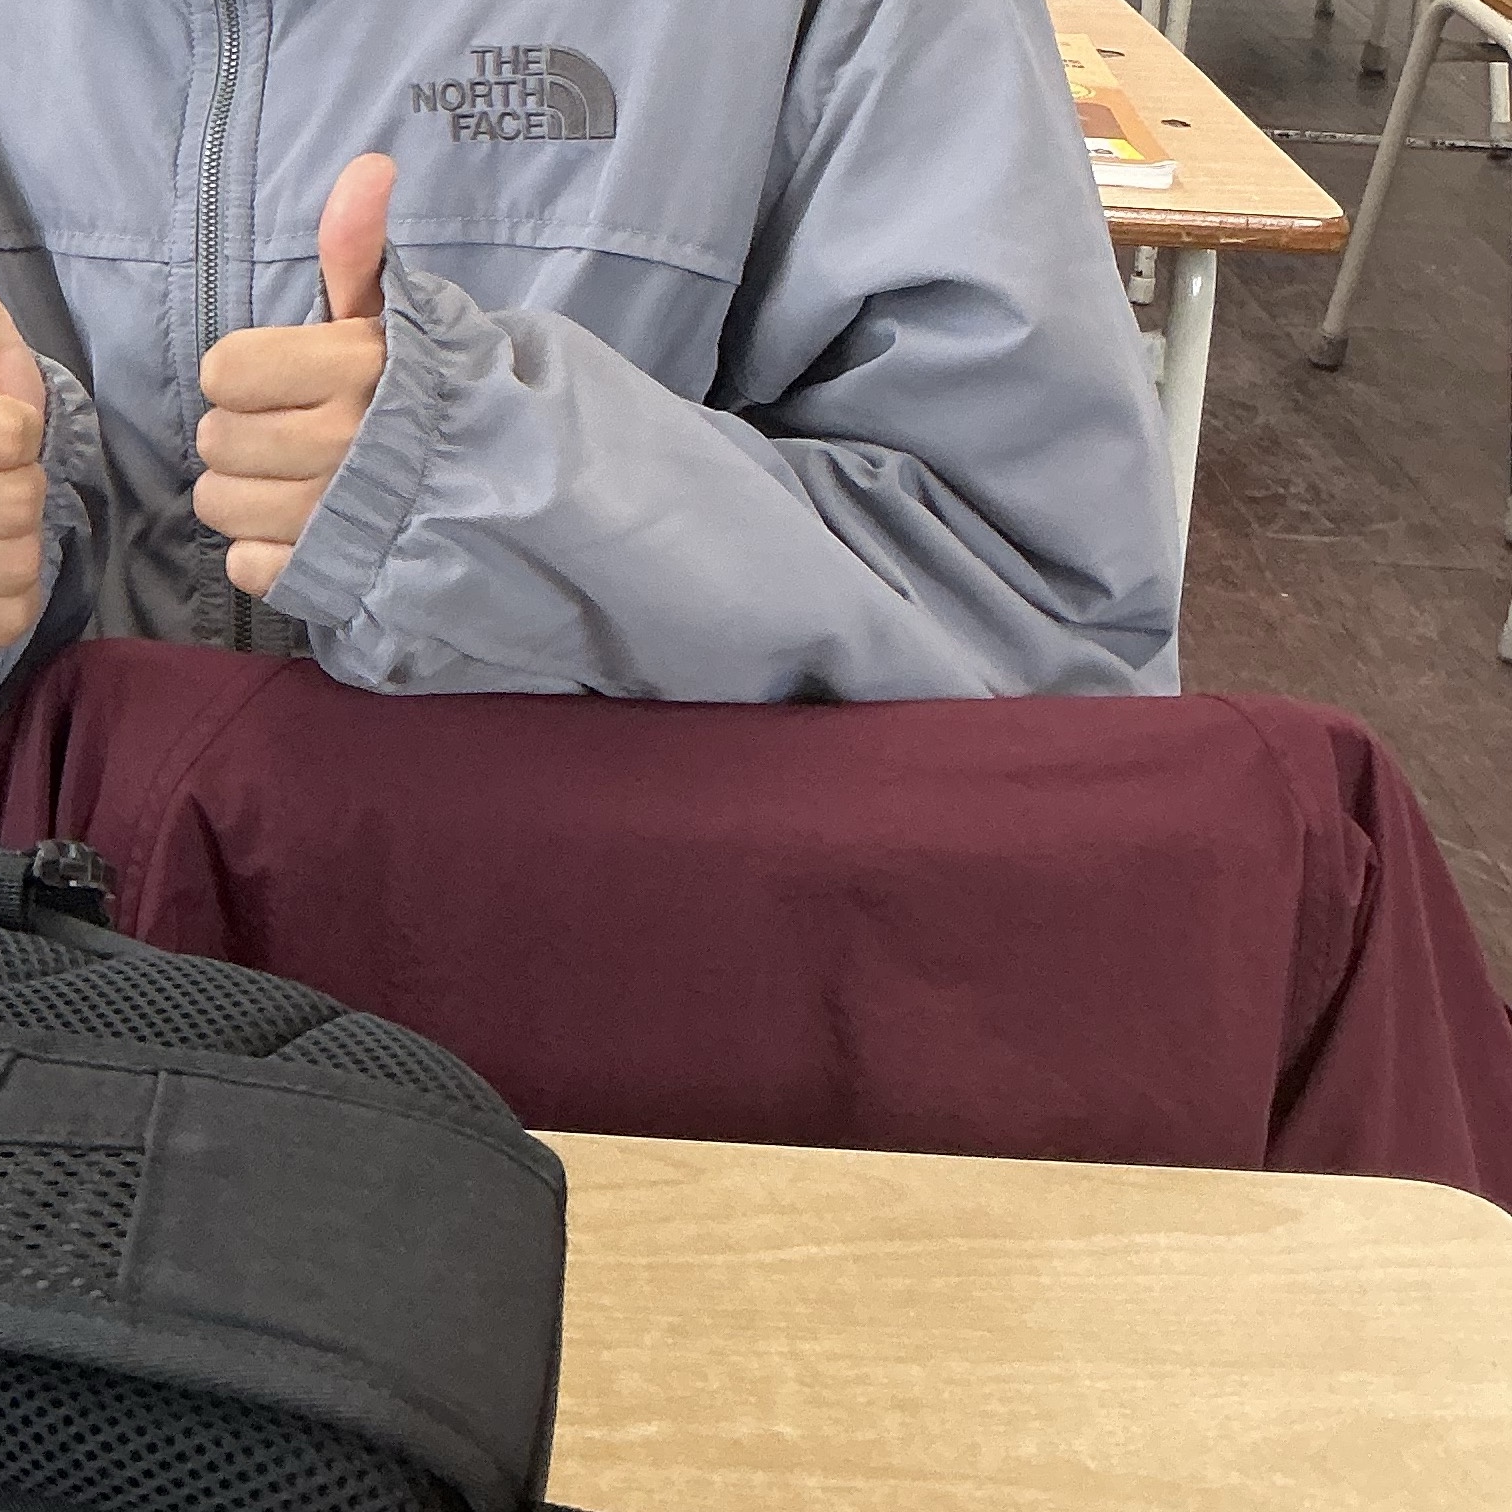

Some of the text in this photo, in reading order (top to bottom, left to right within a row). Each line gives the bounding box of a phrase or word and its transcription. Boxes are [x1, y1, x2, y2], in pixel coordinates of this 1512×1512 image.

[469, 44, 545, 76] THE
[410, 76, 546, 113] NORTH
[449, 109, 547, 143] FACE
